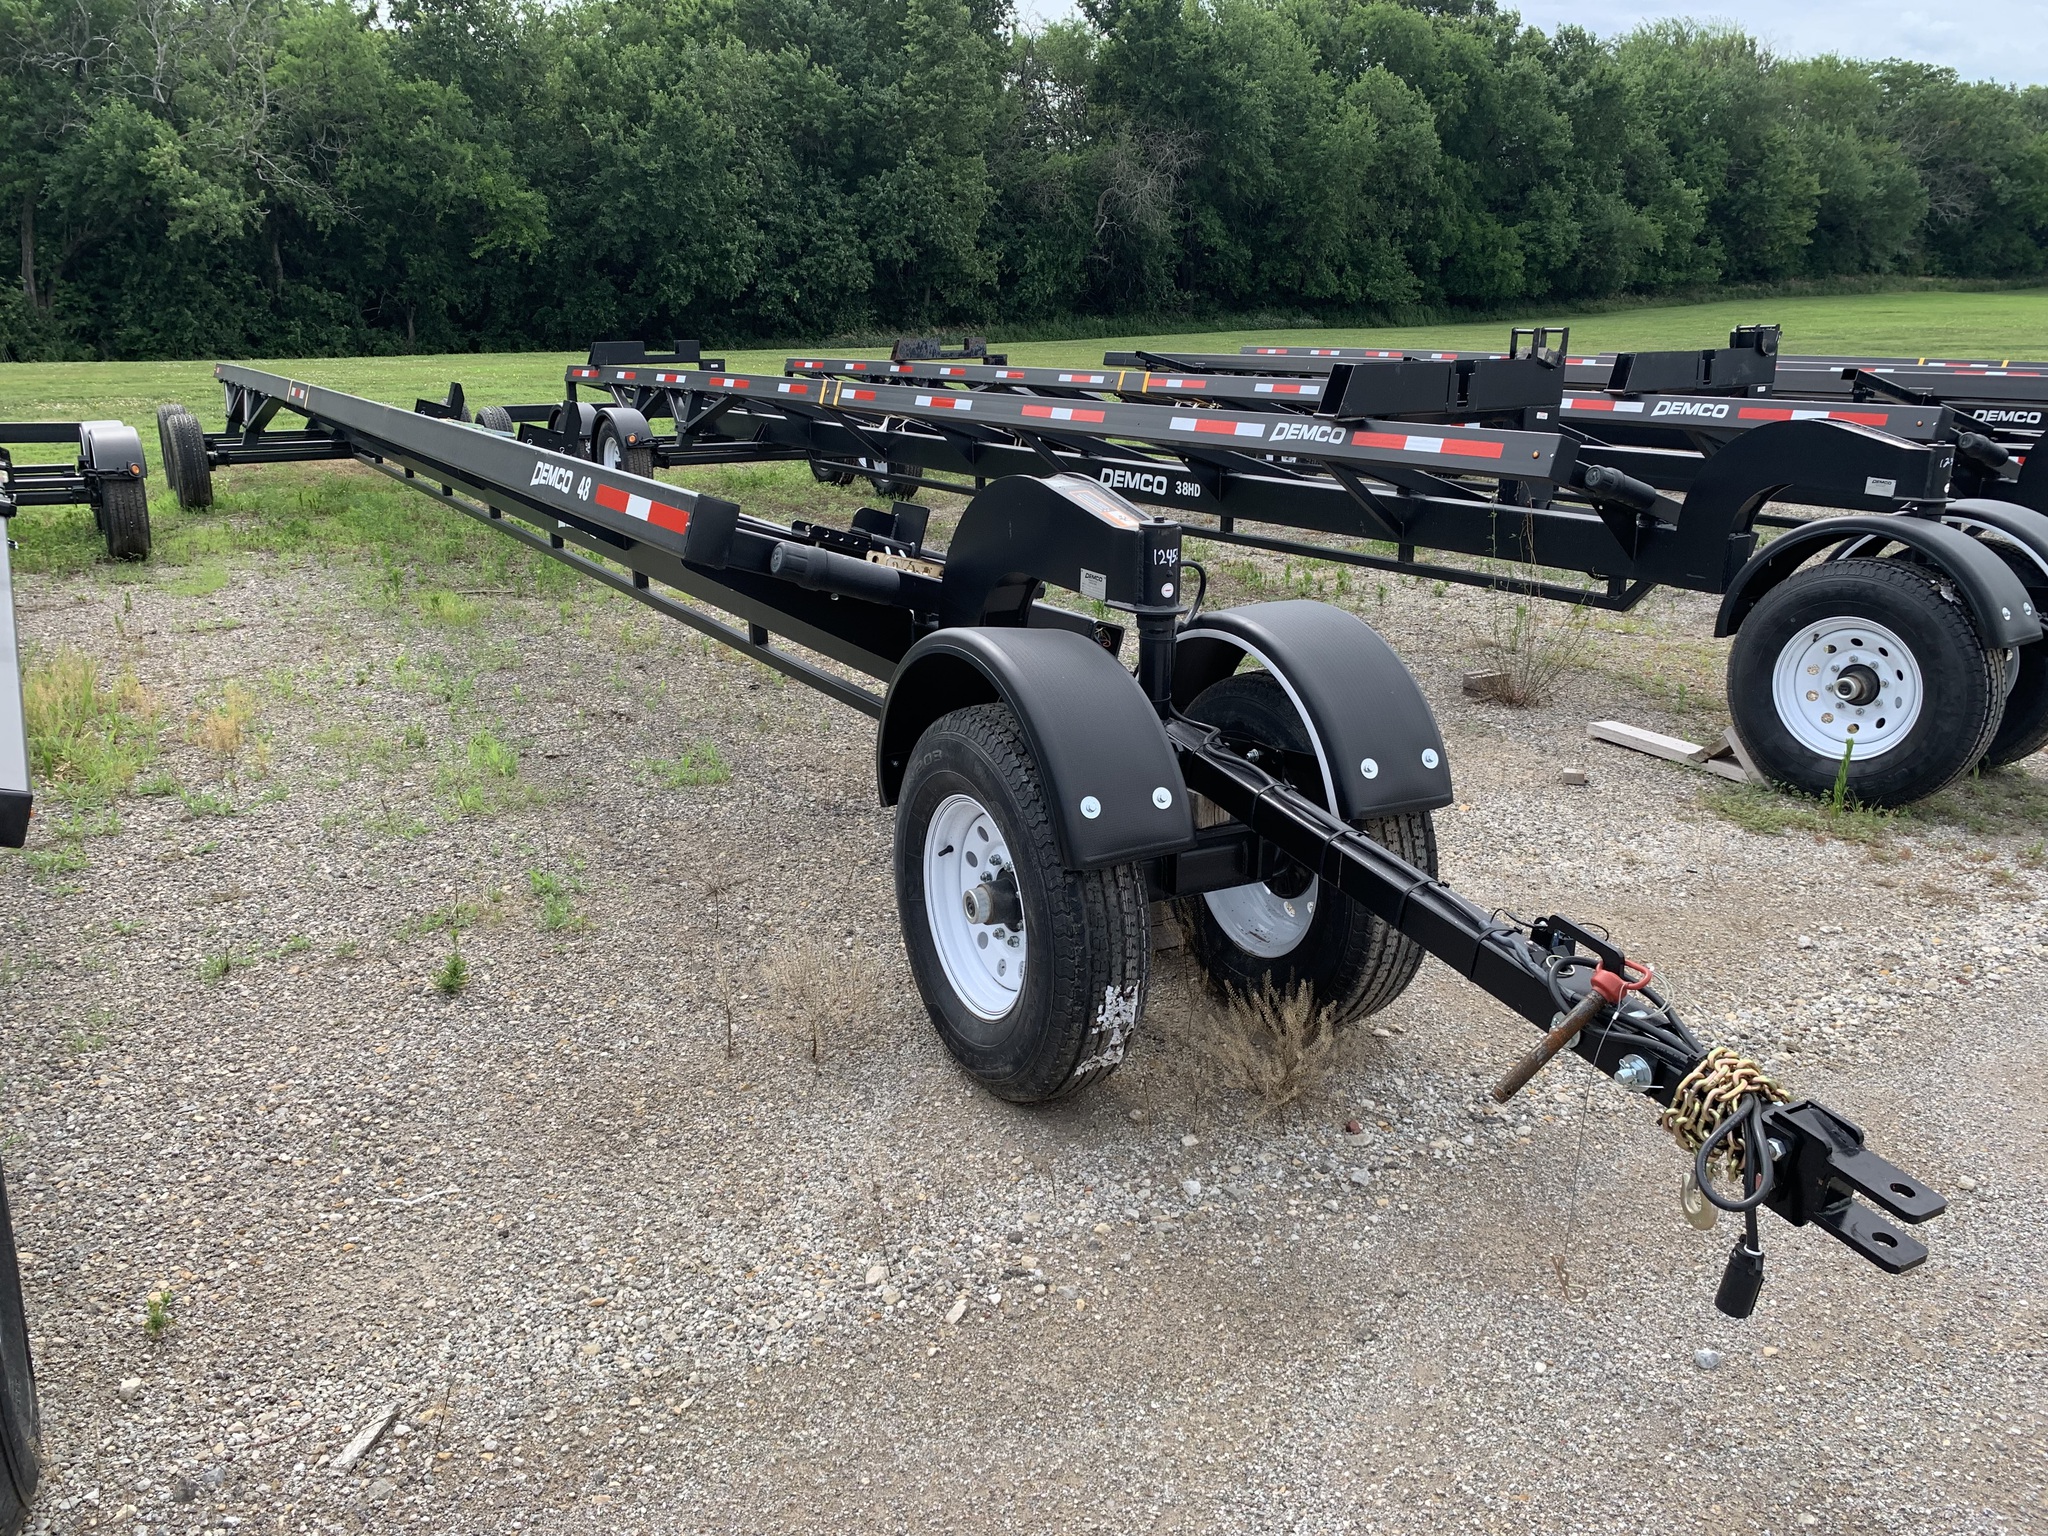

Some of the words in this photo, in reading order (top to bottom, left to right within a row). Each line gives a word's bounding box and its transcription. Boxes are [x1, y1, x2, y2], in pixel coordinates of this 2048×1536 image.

[1650, 400, 1730, 419] DEMCO
[1972, 409, 2042, 425] DEMCO
[1268, 422, 1347, 445] DEMCO
[530, 461, 574, 494] DEMCO
[577, 475, 592, 501] 48
[1099, 468, 1168, 496] DEMCO
[1175, 480, 1201, 498] 38HD
[1085, 572, 1103, 582] DEMCO
